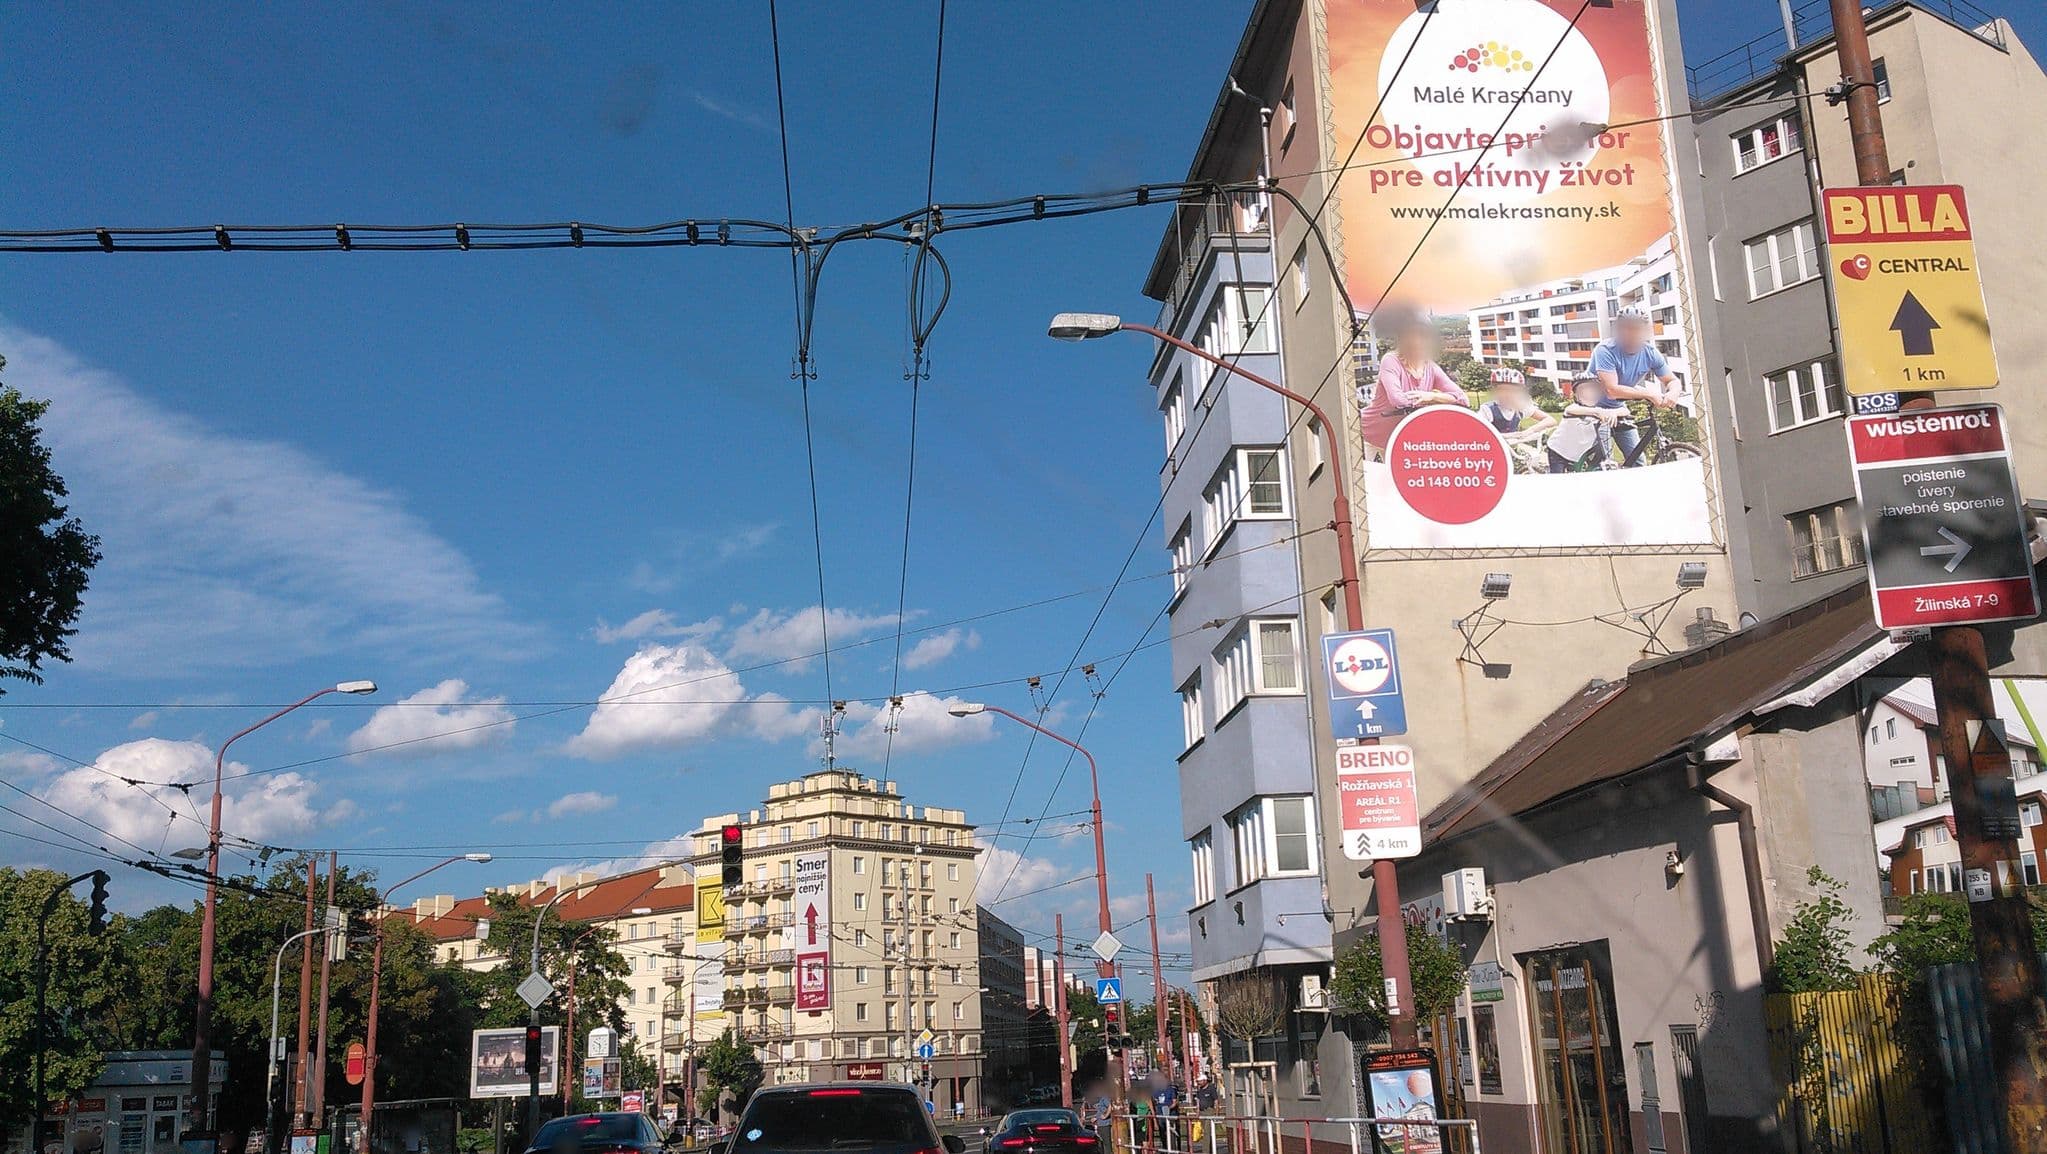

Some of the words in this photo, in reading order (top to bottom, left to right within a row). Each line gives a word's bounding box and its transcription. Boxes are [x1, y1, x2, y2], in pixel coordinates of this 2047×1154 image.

[1413, 86, 1465, 103] Malé
[1366, 124, 1493, 158] Objavte
[1505, 125, 1631, 156] prior
[1370, 168, 1424, 194] pre
[1433, 162, 1550, 194] aktívny
[1559, 162, 1635, 186] život
[1390, 202, 1621, 222] www.malekrasnany.sk
[1829, 193, 1967, 235] BILLA
[1878, 257, 1970, 274] CENTRAL
[1903, 368, 1911, 381] 1
[1918, 367, 1945, 381] km
[1857, 393, 1897, 410] ROS
[1403, 441, 1491, 451] Nadštandardné
[1403, 458, 1462, 469] 3-izbové
[1464, 457, 1494, 471] byty
[1407, 476, 1425, 487] od
[1428, 476, 1451, 487] 148
[1454, 476, 1480, 487] 000
[1484, 475, 1497, 487] €
[1902, 467, 1966, 485] poistenie
[1917, 485, 1957, 498] úvery
[1879, 501, 1939, 518] stavebné
[1943, 495, 2005, 514] sporenie
[1914, 596, 1971, 613] Žilinská
[1975, 593, 1999, 608] 7-9
[1356, 723, 1363, 734] 1
[1366, 722, 1383, 734] km
[1339, 750, 1410, 768] BRENO
[1341, 778, 1402, 791] Rožňavská
[1356, 795, 1387, 806] AREÁL
[1377, 839, 1385, 848] 4
[1388, 838, 1408, 848] km
[796, 858, 827, 872] Smer
[798, 880, 824, 895] ceny!
